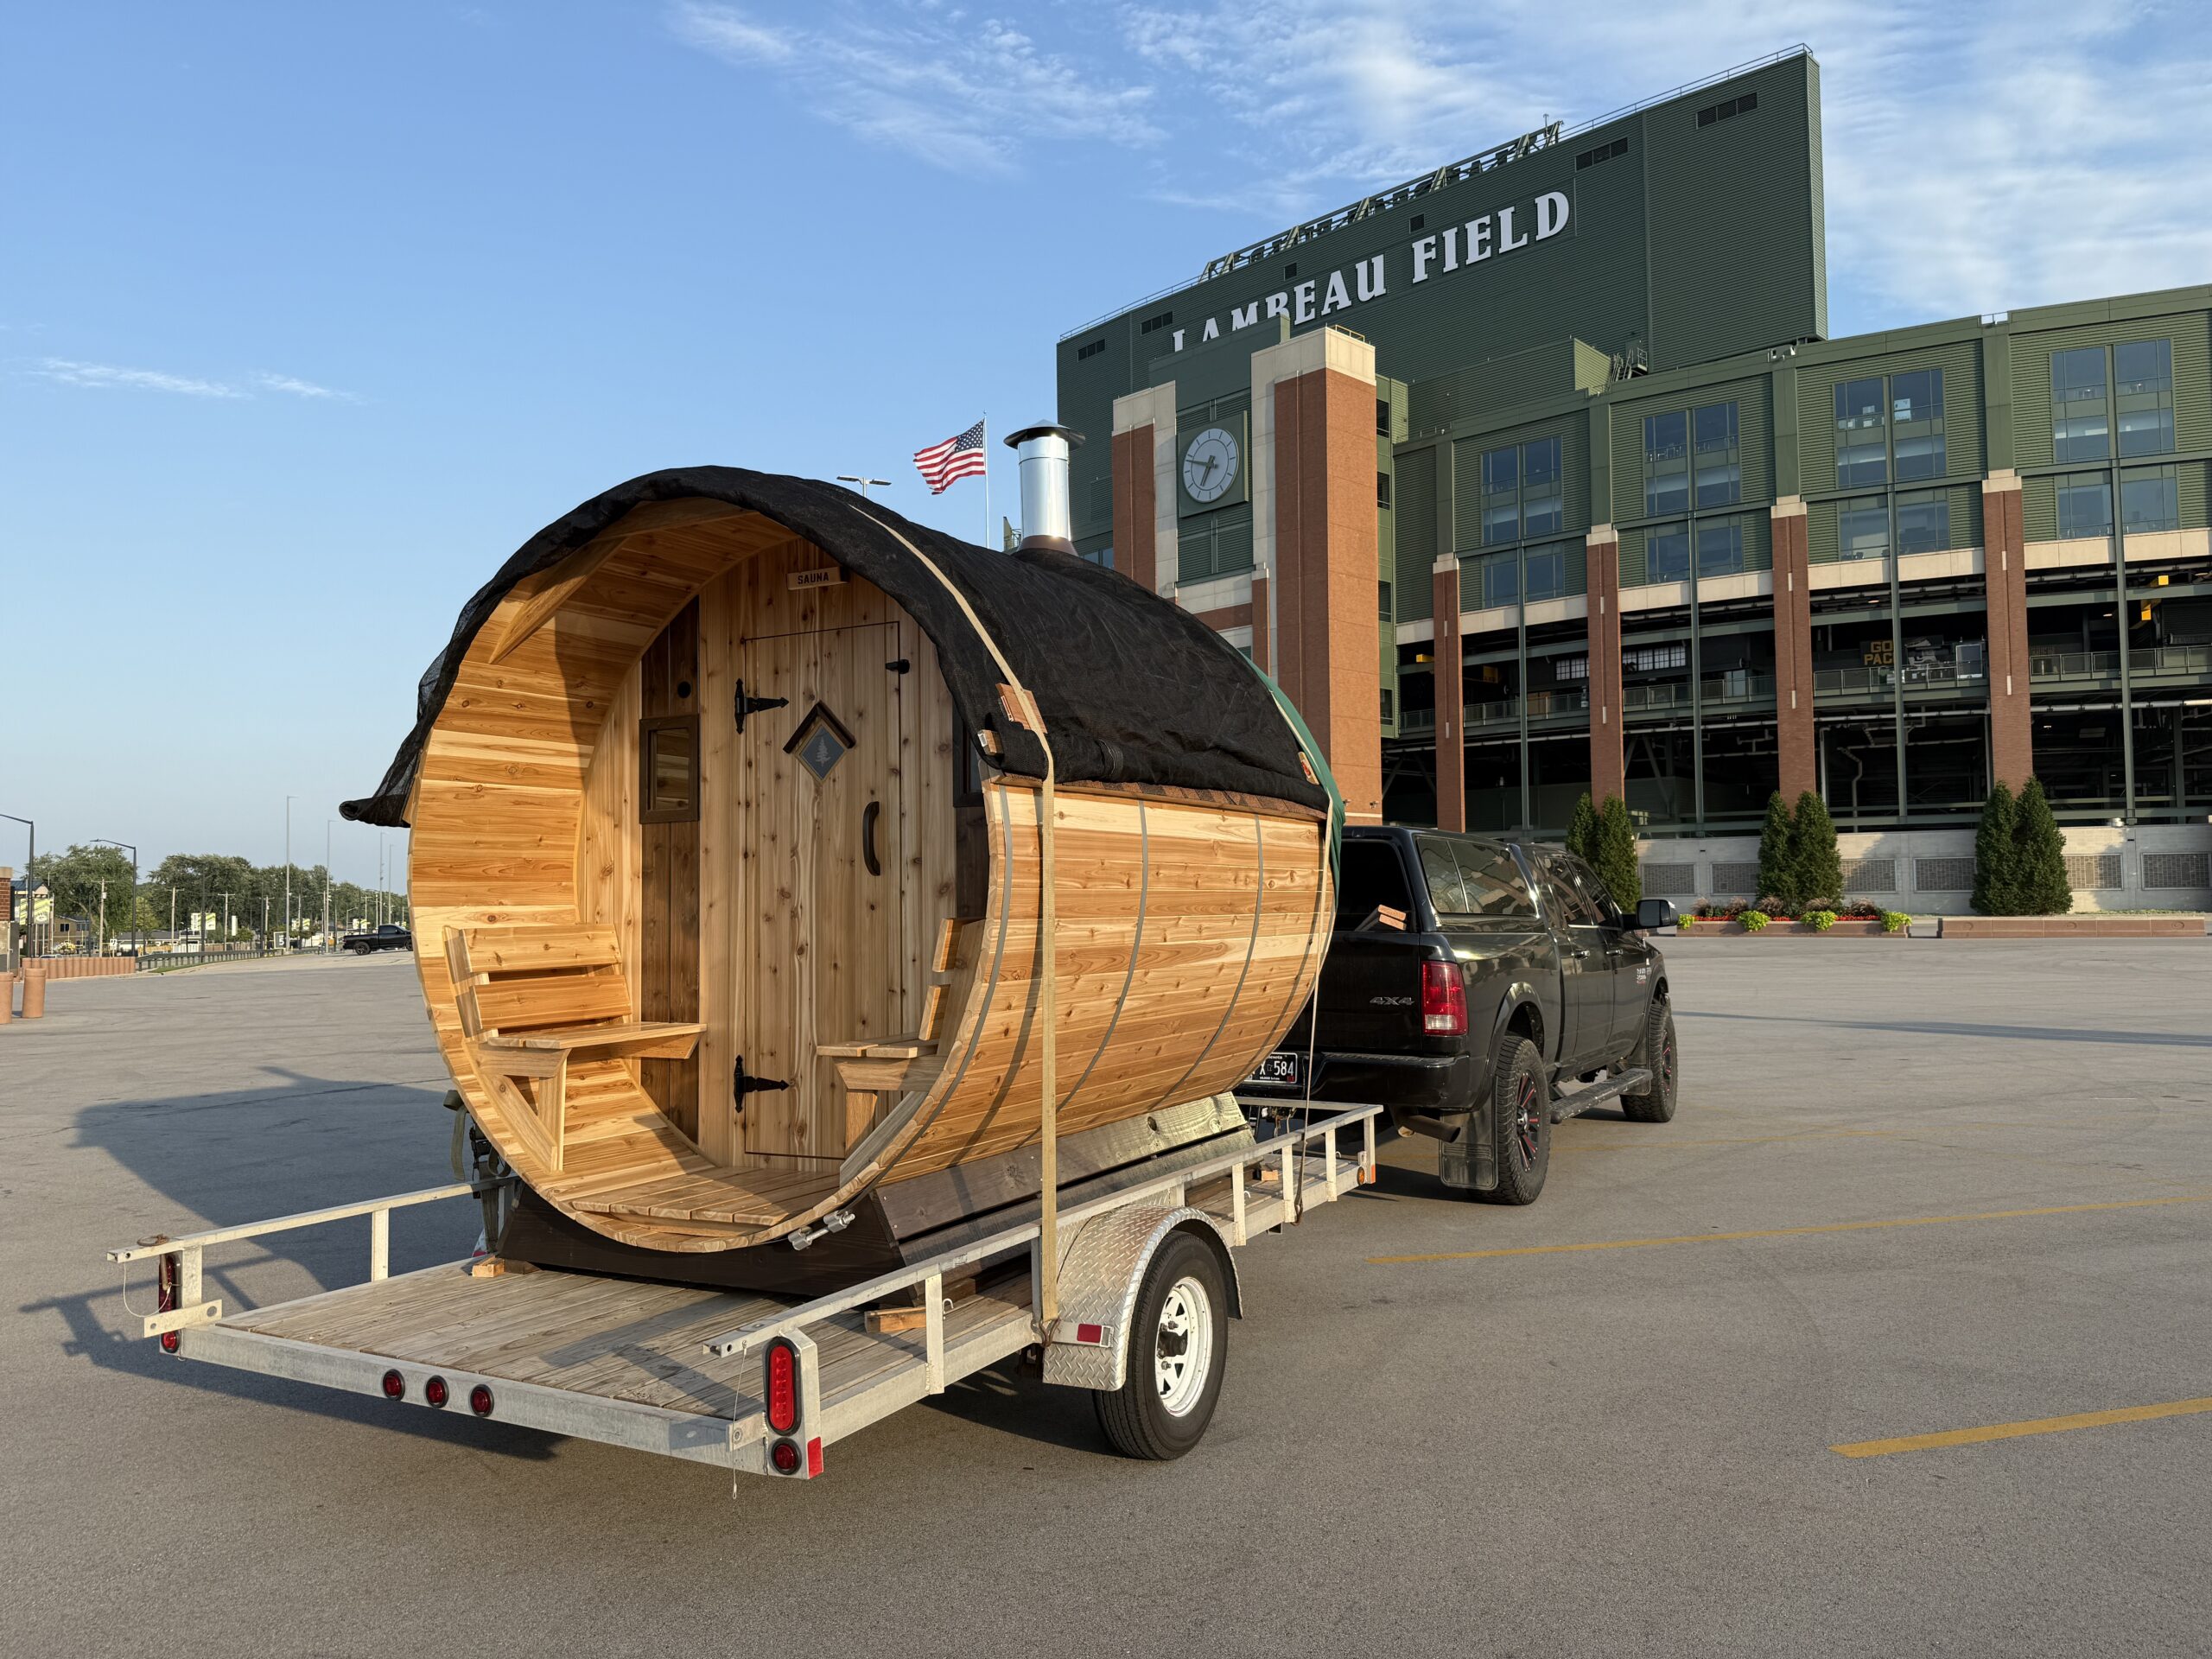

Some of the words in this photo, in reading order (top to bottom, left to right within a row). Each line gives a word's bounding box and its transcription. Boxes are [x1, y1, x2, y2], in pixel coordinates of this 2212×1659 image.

[1412, 191, 1570, 284] FIELD
[798, 572, 829, 584] SAUNA
[1870, 640, 1894, 652] GO
[1864, 652, 1895, 666] PAC
[1370, 996, 1414, 1006] 4X4
[1274, 1060, 1294, 1076] 584
